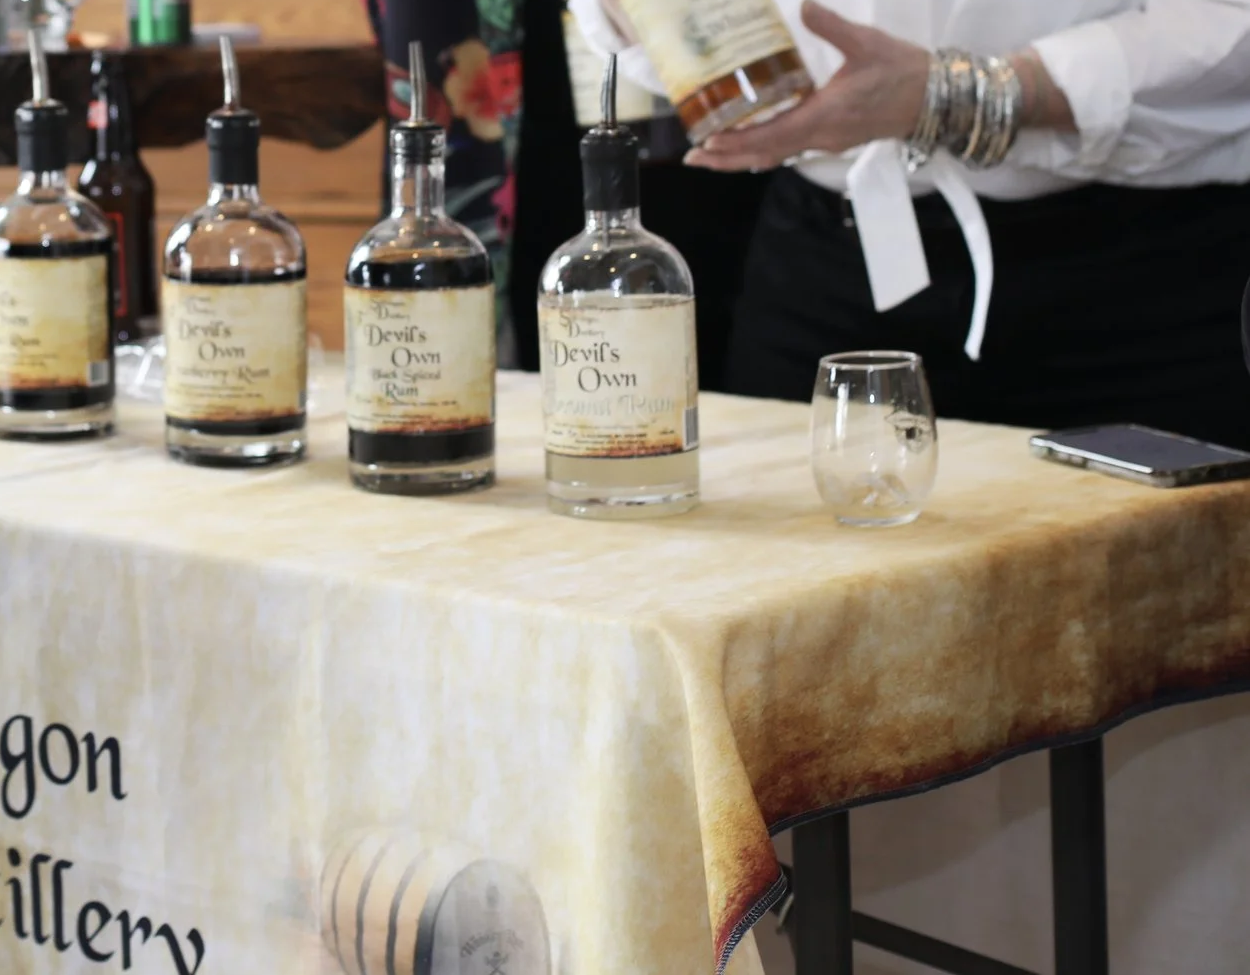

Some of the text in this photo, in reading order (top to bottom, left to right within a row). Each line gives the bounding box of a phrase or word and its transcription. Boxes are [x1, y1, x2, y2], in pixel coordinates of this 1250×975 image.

[365, 324, 427, 346] Devil's
[198, 341, 245, 361] Own
[391, 347, 441, 368] Own
[553, 340, 621, 367] Devil's
[578, 367, 637, 393] Own
[384, 381, 419, 402] Rum
